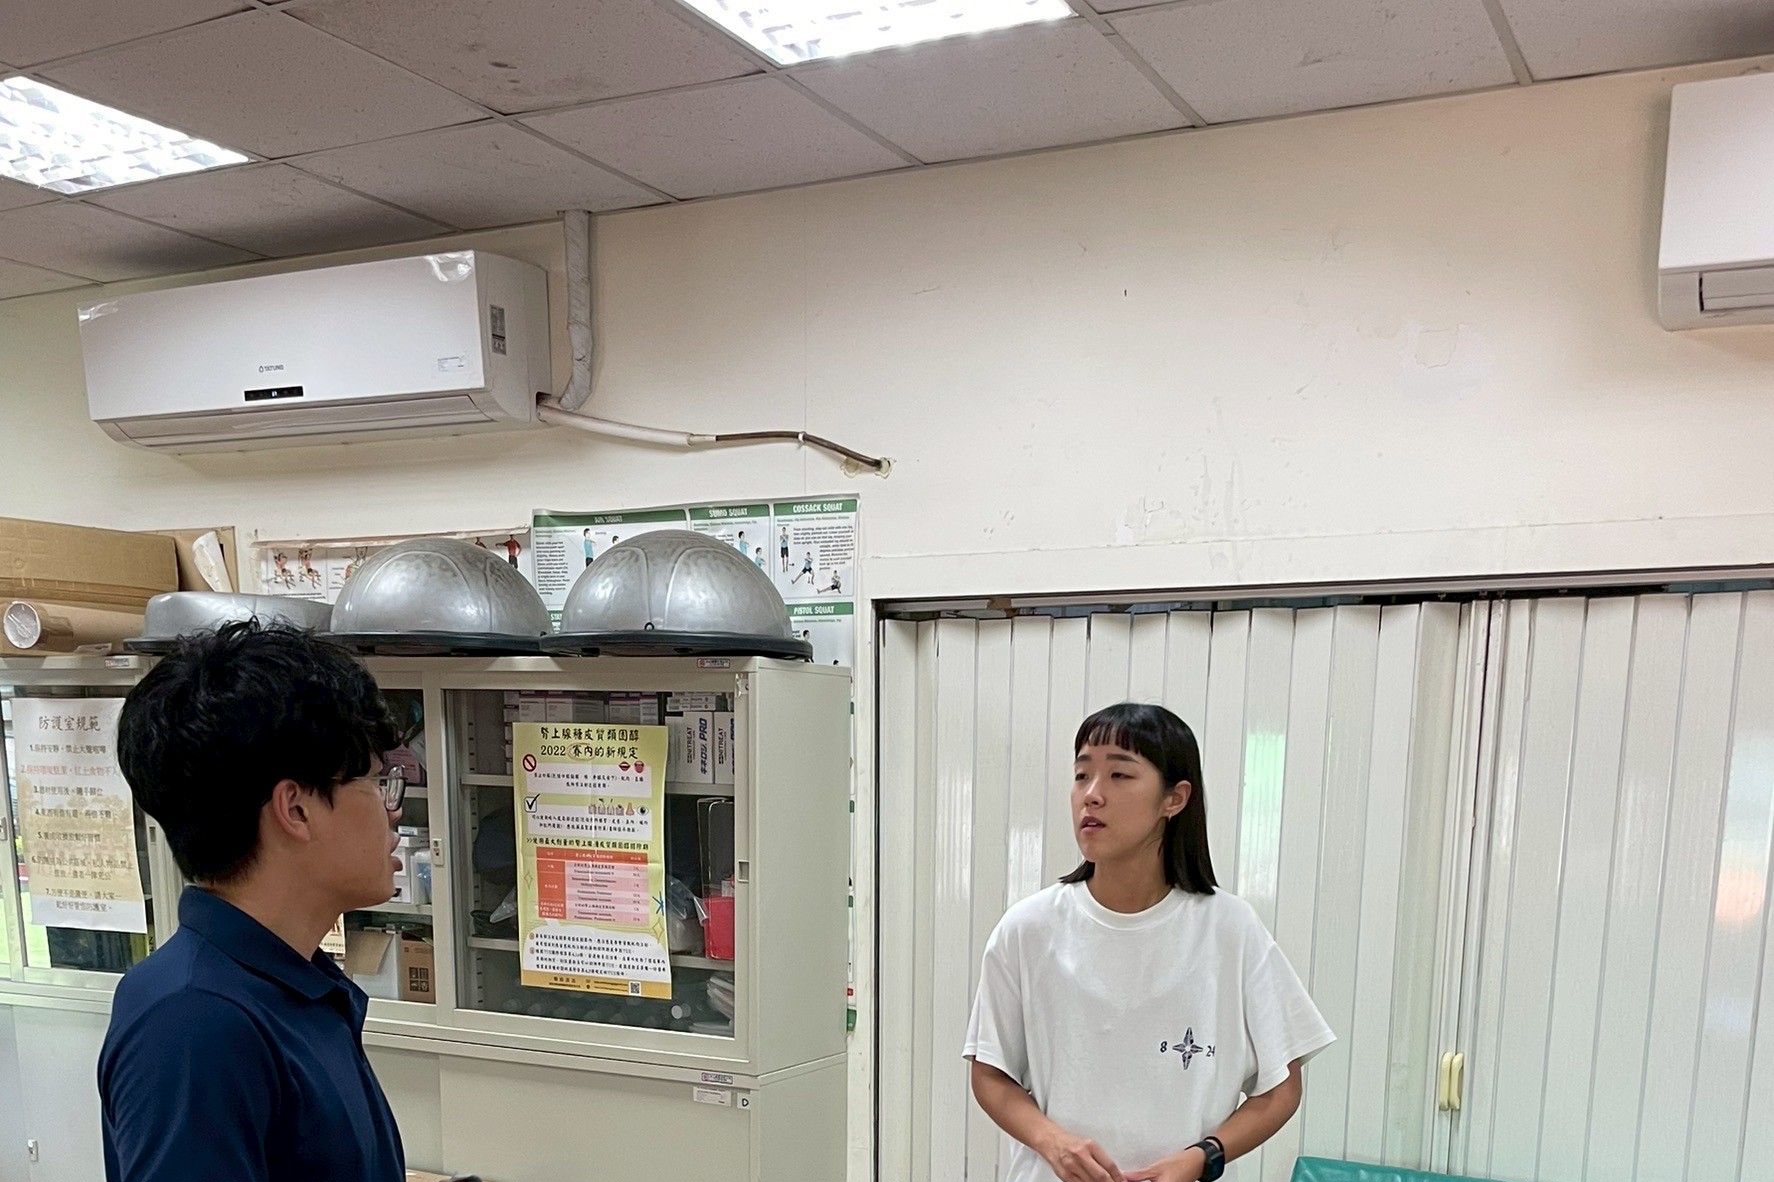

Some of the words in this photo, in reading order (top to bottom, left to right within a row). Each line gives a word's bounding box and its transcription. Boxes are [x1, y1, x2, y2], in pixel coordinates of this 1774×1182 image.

[708, 509, 727, 518] SUMO
[728, 507, 748, 517] SQUAT
[792, 503, 821, 514] COSSACK
[822, 502, 843, 512] SQUAT
[793, 606, 813, 615] PISTOL
[814, 605, 835, 614] SQUAT
[38, 715, 101, 732] 防護室規範
[699, 717, 707, 742] PRO
[540, 745, 566, 756] 2022
[572, 745, 638, 760] 賽內的新規定
[1160, 1041, 1167, 1053] 8
